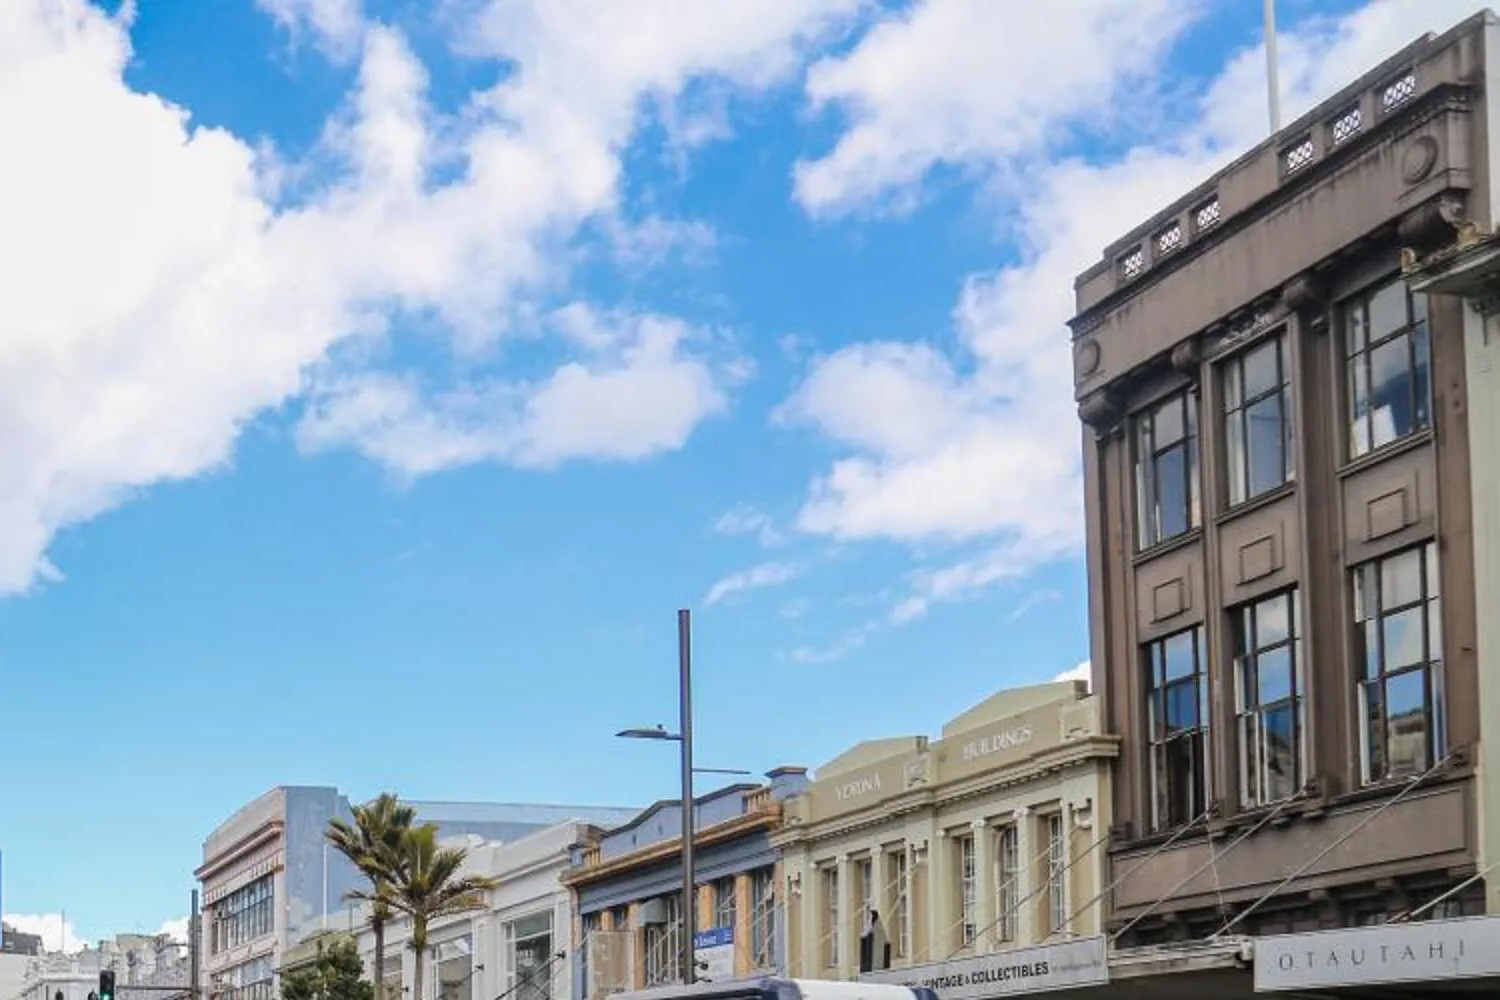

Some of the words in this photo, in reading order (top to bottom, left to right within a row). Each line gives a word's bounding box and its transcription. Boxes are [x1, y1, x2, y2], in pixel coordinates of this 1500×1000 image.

[963, 723, 1034, 761] BUILDINGS
[1278, 939, 1465, 971] OTAUTAHI
[971, 961, 1049, 985] COLLECTIBLES
